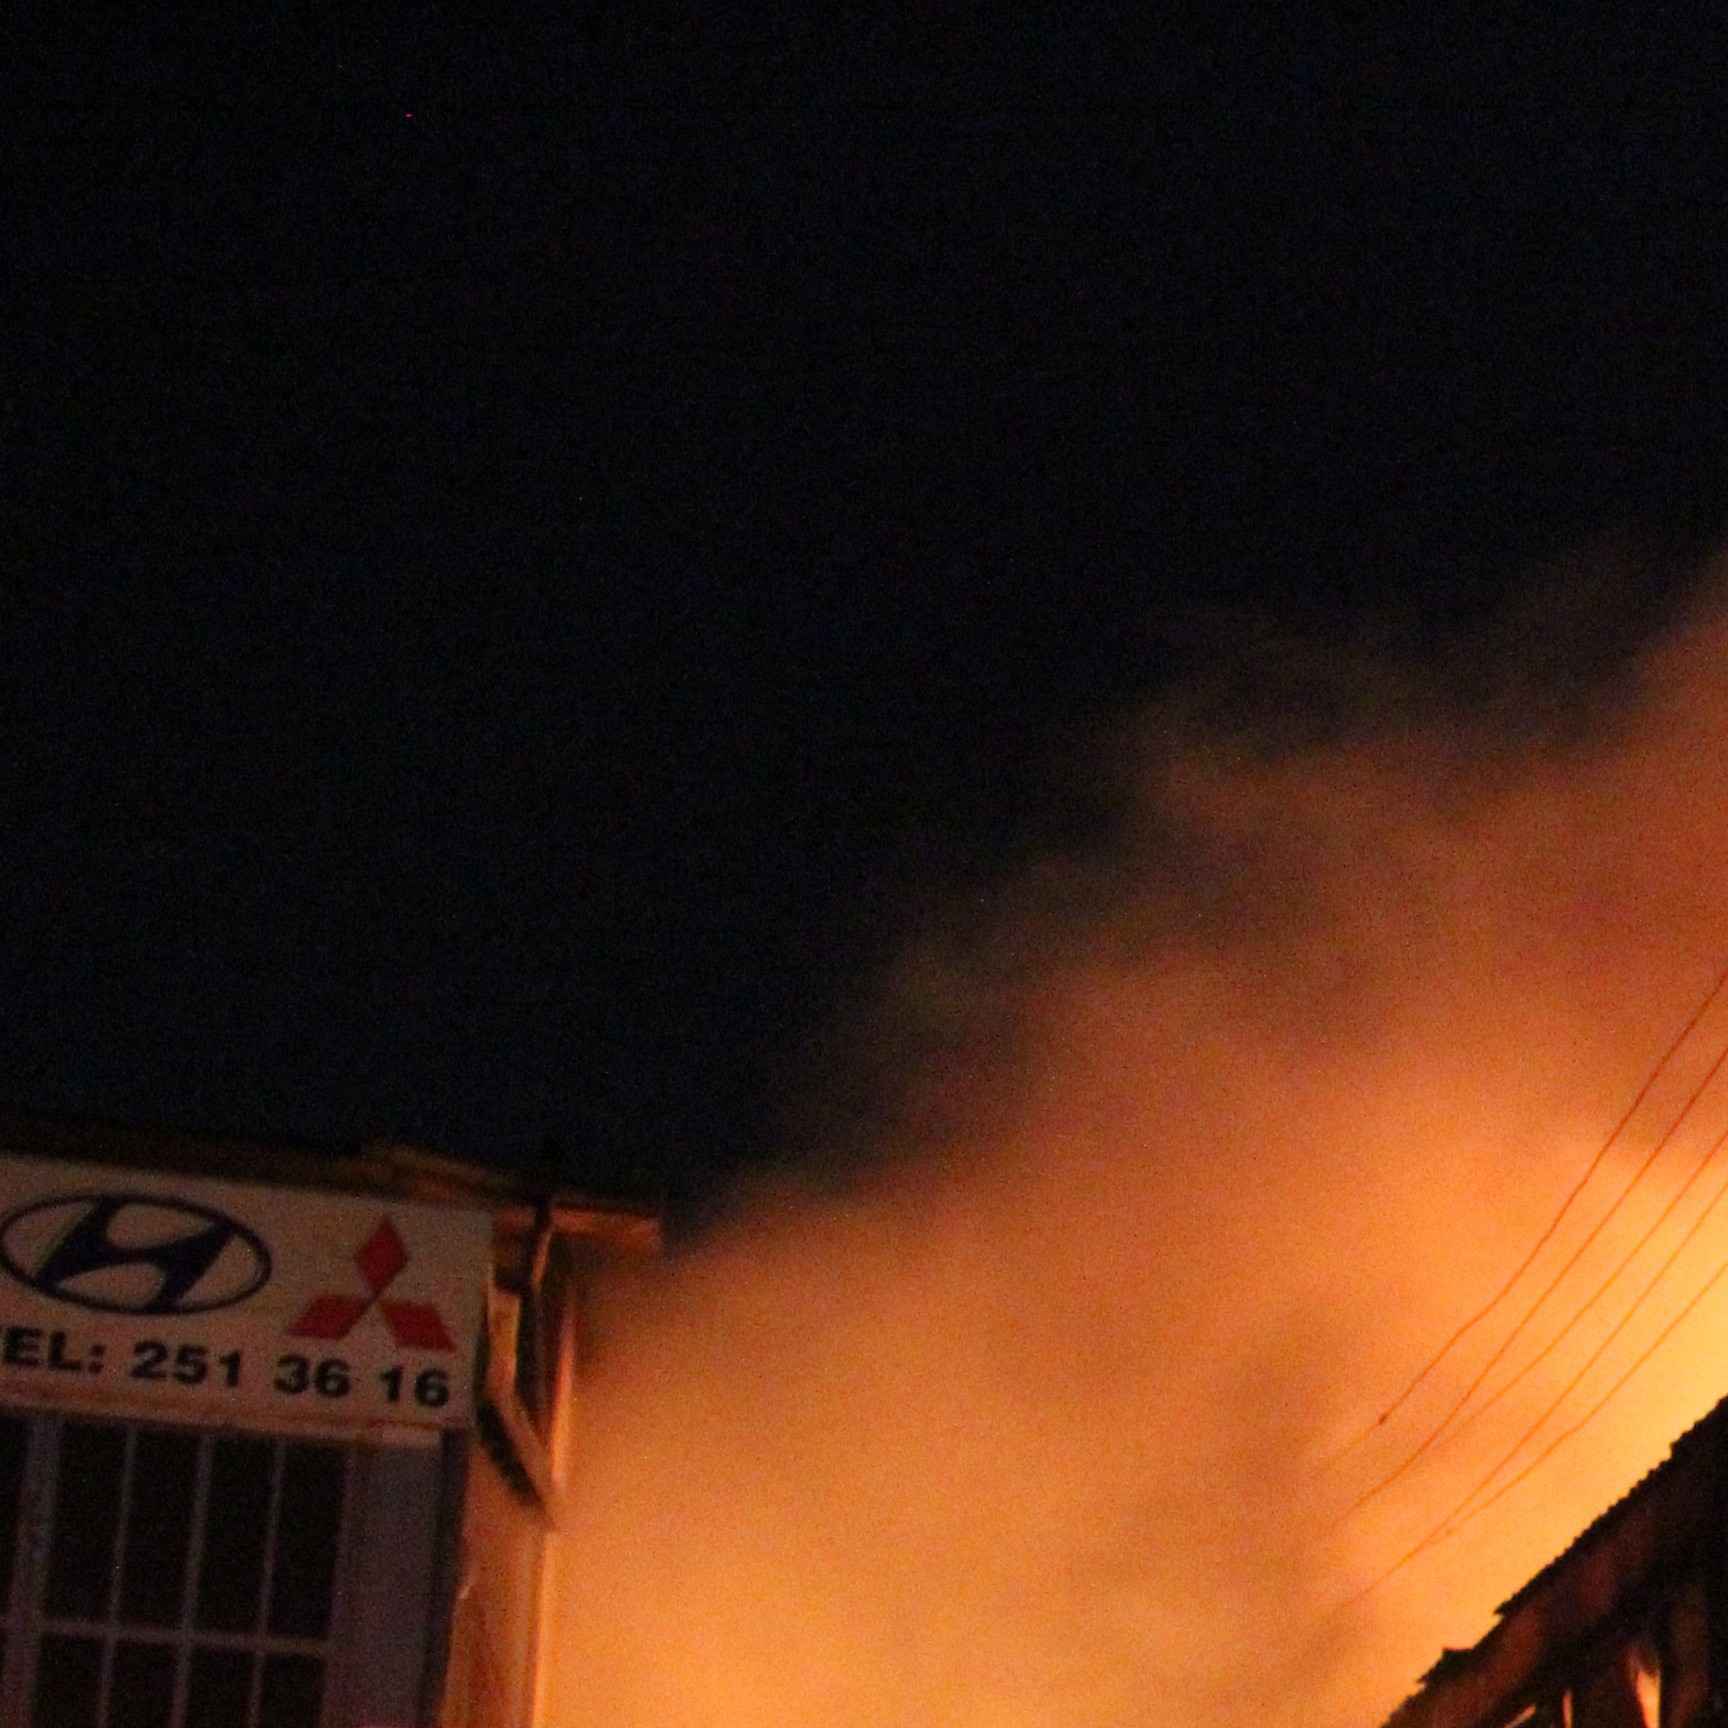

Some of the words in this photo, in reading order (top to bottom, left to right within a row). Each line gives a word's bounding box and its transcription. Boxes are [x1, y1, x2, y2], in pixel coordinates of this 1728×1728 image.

[0, 1325, 106, 1374] EL:
[130, 1340, 242, 1389] 251
[273, 1353, 352, 1398] 36
[379, 1366, 450, 1409] 16
